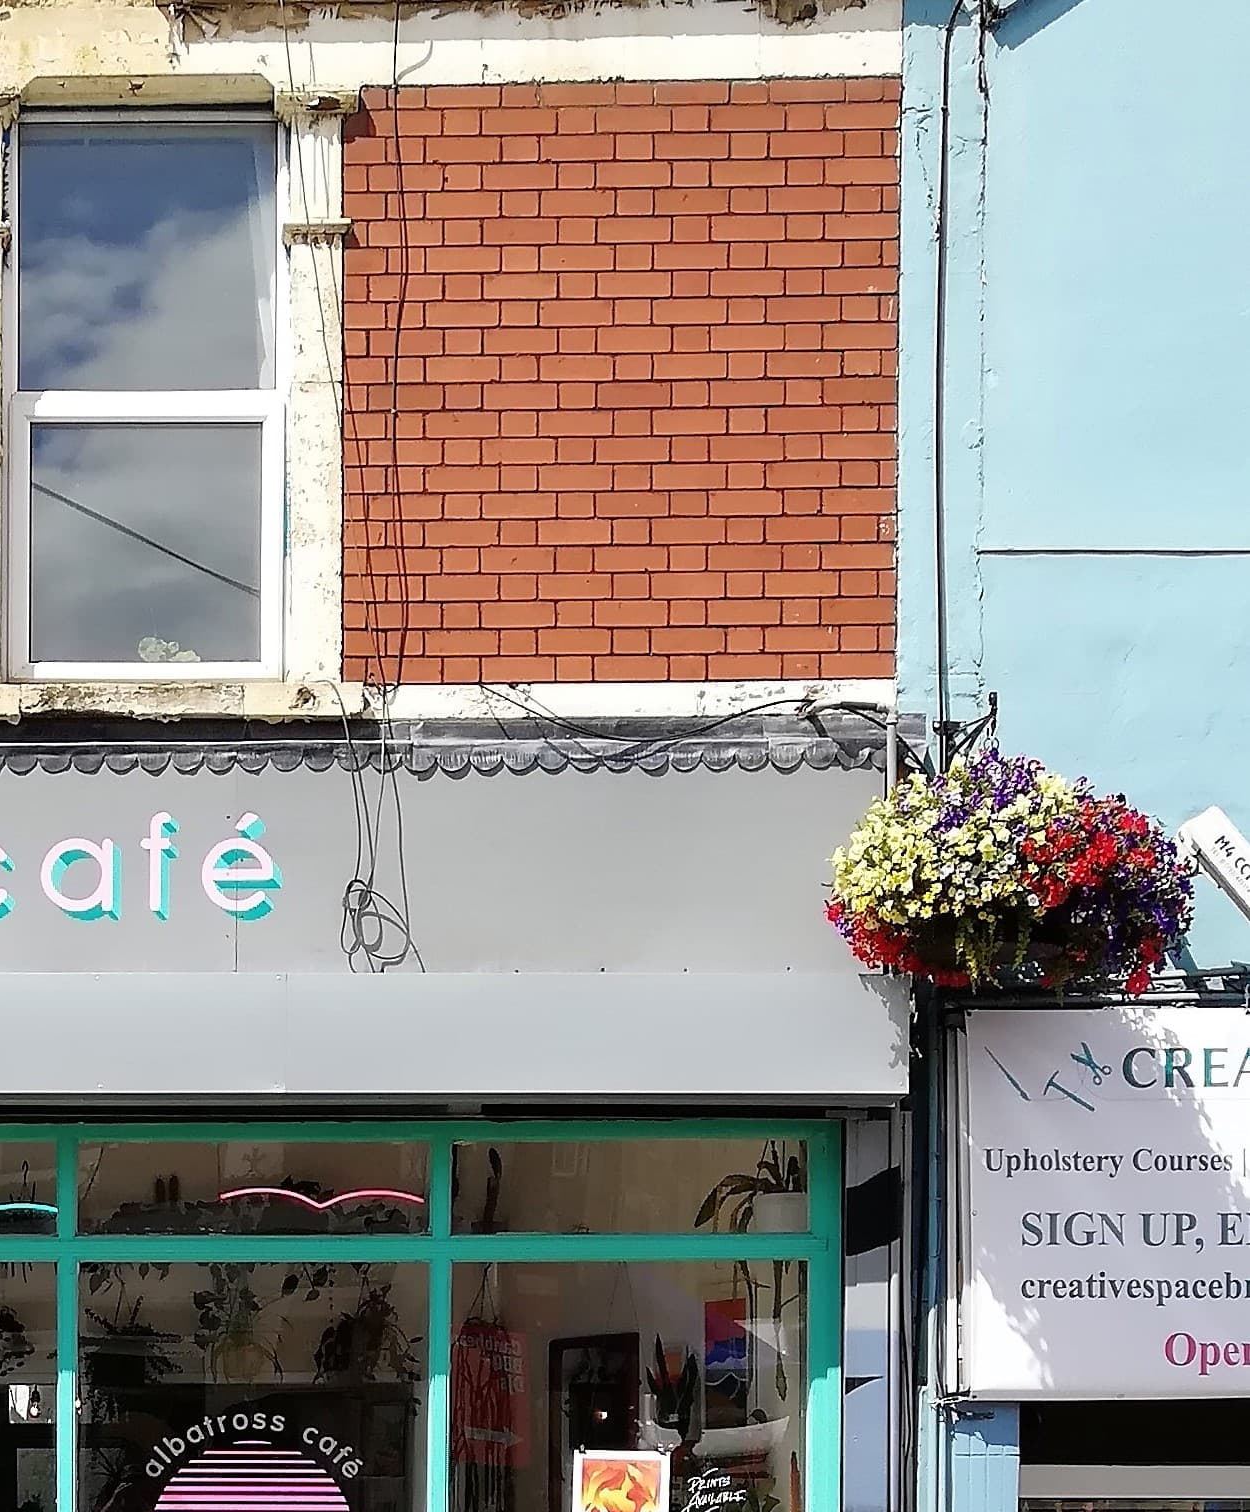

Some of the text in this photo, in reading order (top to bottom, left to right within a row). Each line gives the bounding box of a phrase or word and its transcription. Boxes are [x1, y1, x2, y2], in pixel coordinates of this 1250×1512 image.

[984, 1148, 1233, 1177] Upholstery Courses
[1021, 1211, 1250, 1253] SIGN UP, E
[145, 1412, 364, 1479] albatross café
